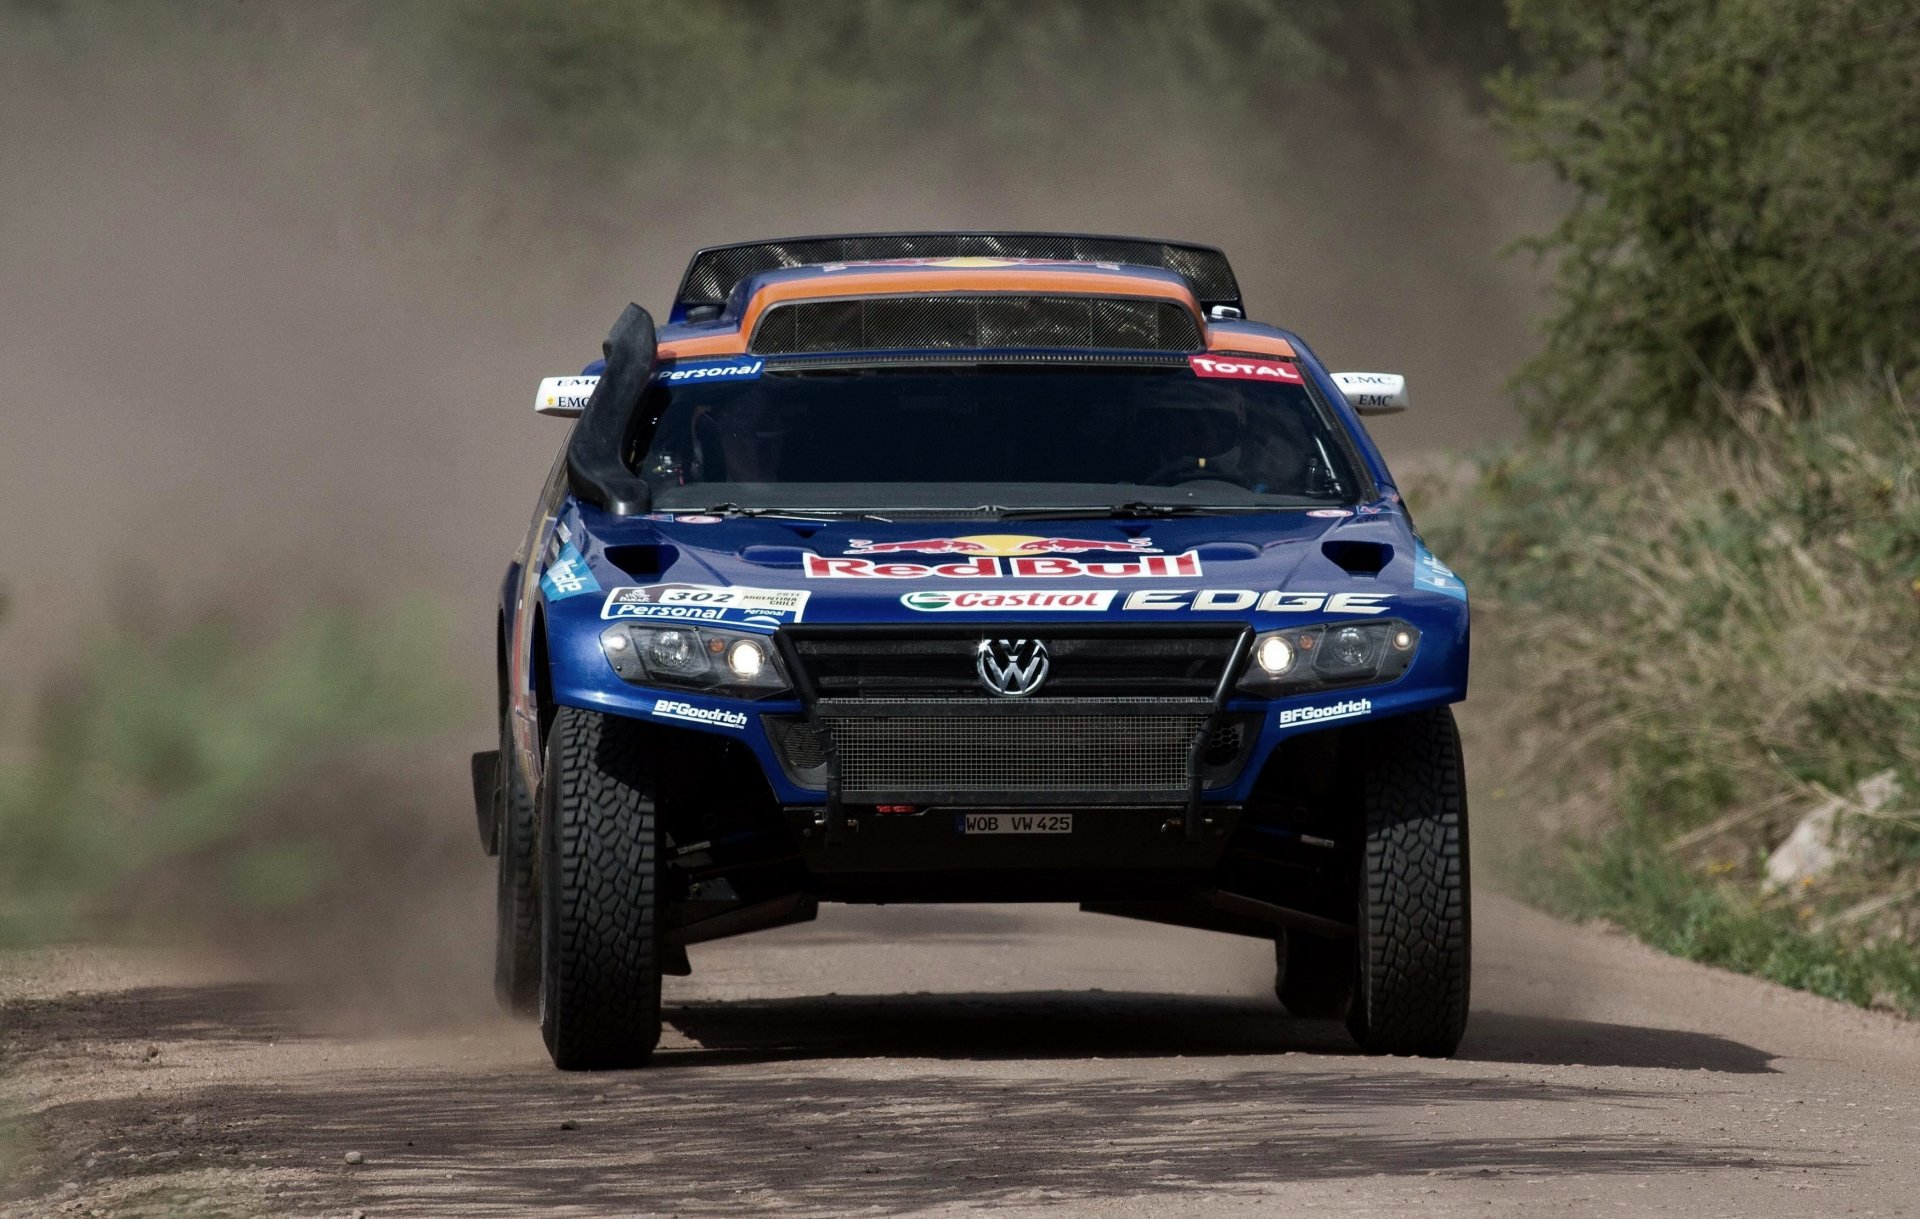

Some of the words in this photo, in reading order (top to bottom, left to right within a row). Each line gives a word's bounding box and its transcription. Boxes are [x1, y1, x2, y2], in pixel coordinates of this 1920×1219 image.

[657, 361, 763, 380] Personal
[1193, 358, 1298, 378] TOTAL
[808, 556, 999, 577] Red
[1016, 552, 1198, 577] Bull
[668, 591, 735, 603] 302
[954, 592, 1099, 608] Castrol
[1122, 589, 1398, 614] EDGE
[617, 603, 728, 620] Personal
[653, 699, 748, 725] BFGoodrich
[1279, 698, 1372, 724] BFGoodrich
[966, 816, 999, 831] WOB
[1011, 816, 1033, 831] VW
[1036, 816, 1070, 831] 425
